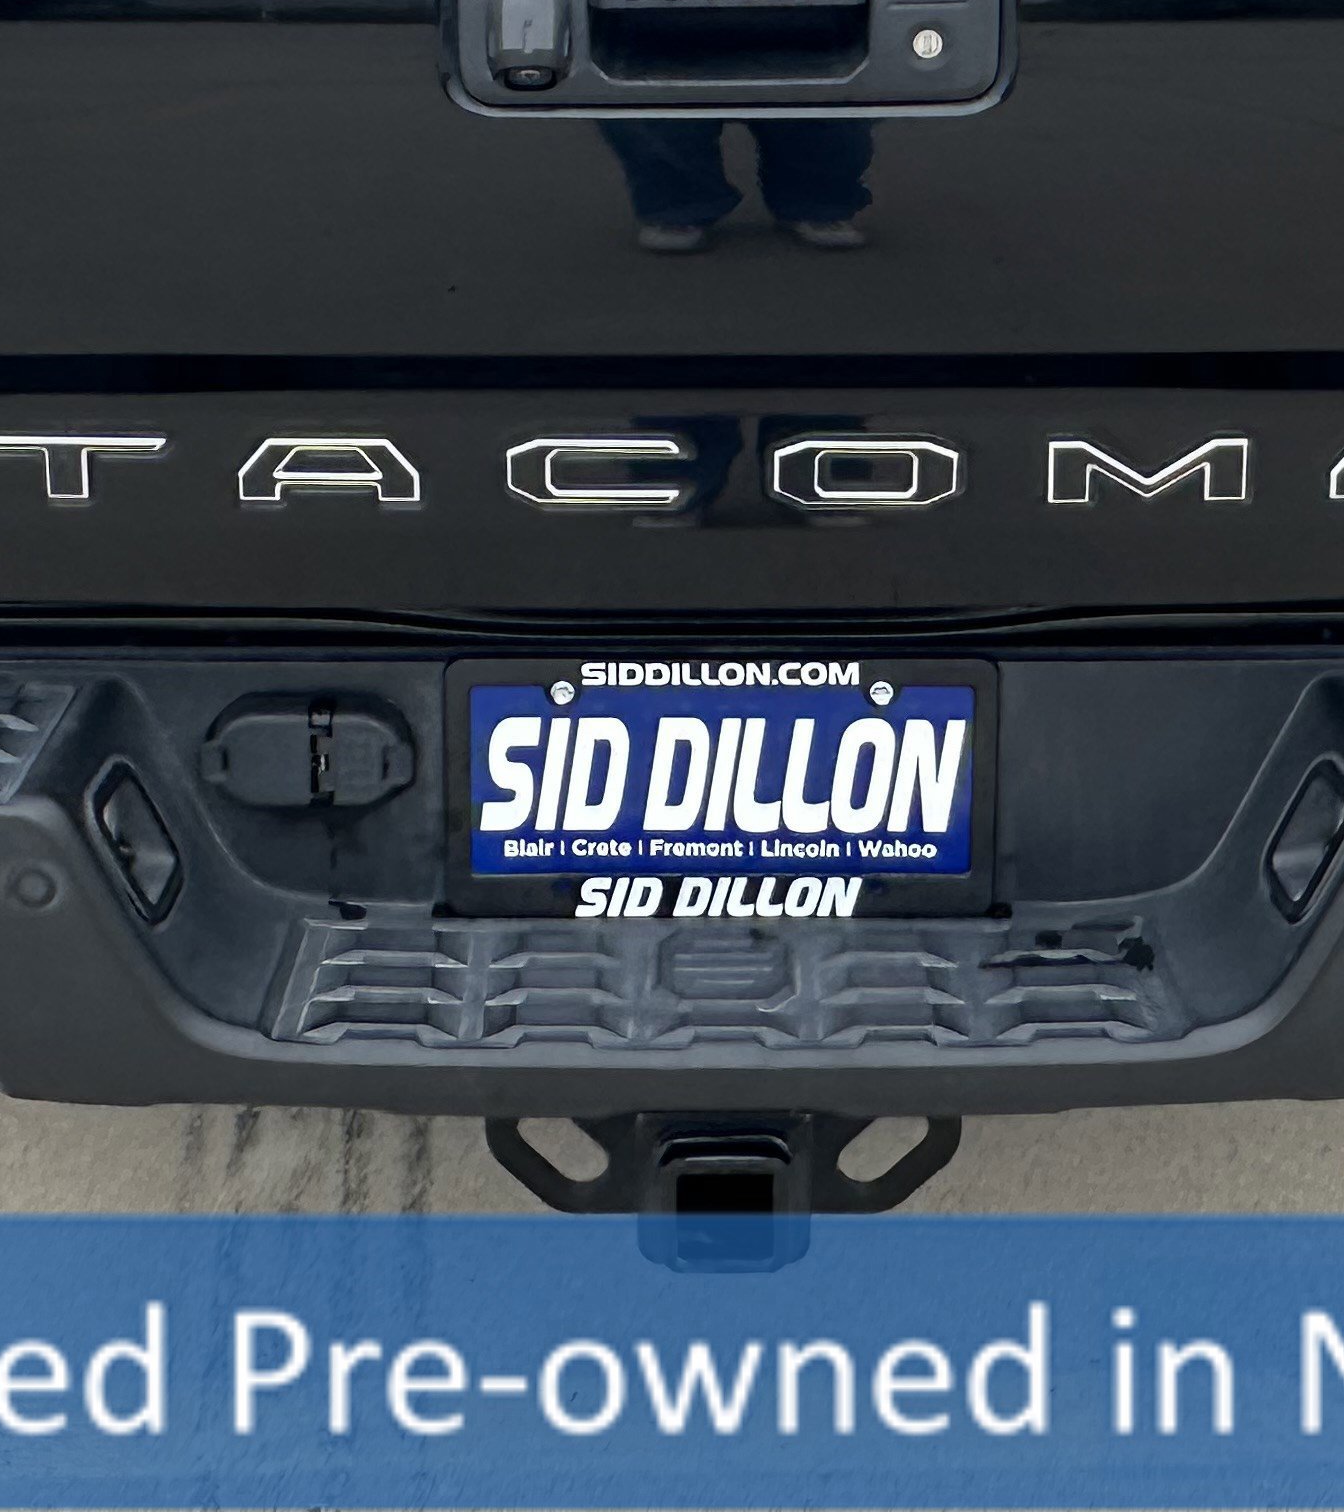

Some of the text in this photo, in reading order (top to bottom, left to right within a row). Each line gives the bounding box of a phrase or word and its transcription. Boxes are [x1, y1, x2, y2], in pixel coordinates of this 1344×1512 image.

[580, 662, 860, 686] SIDDILLON.COM
[479, 716, 967, 834] SID DILLON
[503, 838, 555, 858] Blair
[760, 838, 840, 859] Lincoln
[858, 839, 938, 859] Wahoo
[574, 876, 863, 918] SID DILLON
